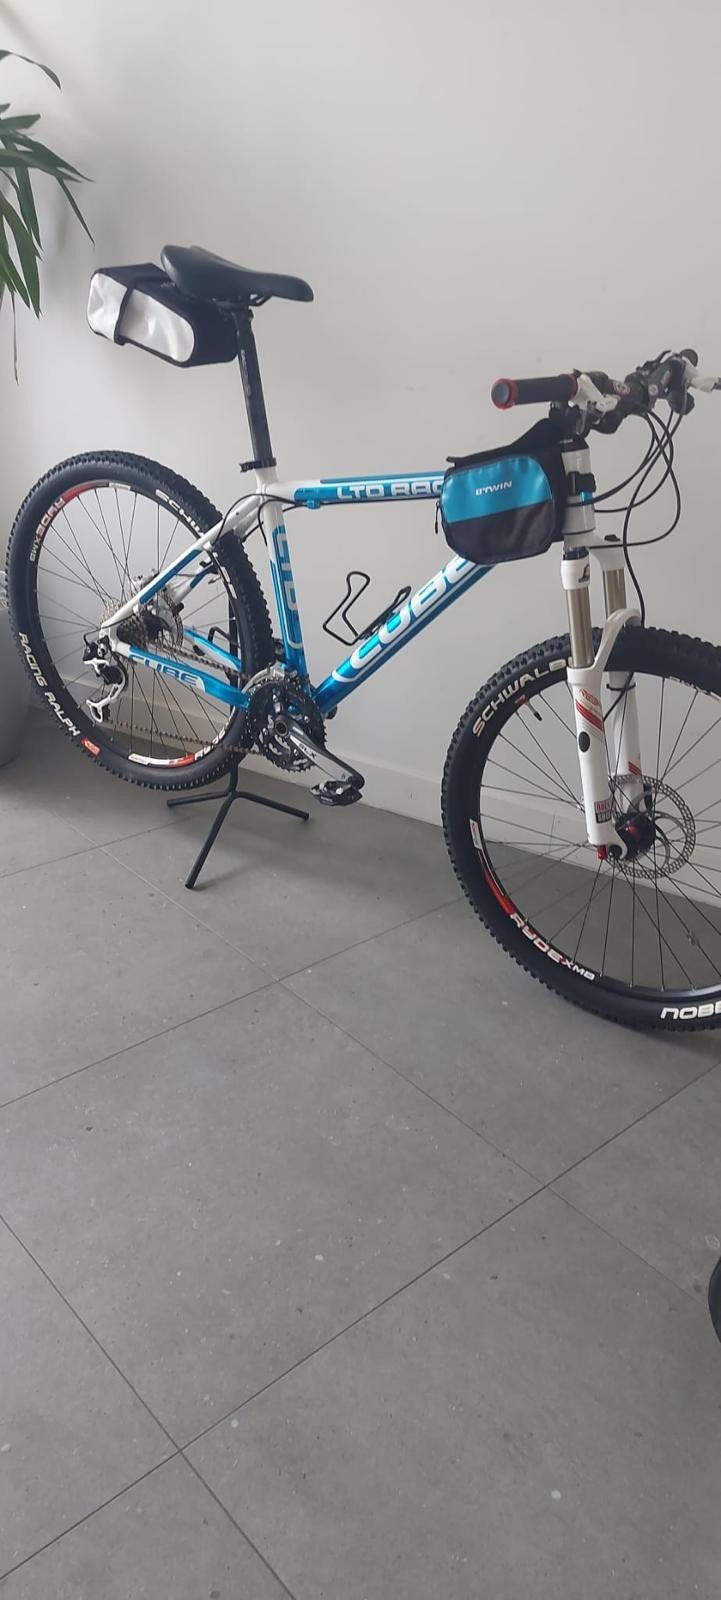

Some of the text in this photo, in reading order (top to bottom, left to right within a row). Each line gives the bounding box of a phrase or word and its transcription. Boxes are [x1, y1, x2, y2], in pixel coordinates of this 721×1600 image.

[336, 484, 384, 499] LTD
[350, 555, 477, 669] CUBE
[18, 631, 81, 736] RACING RALPH
